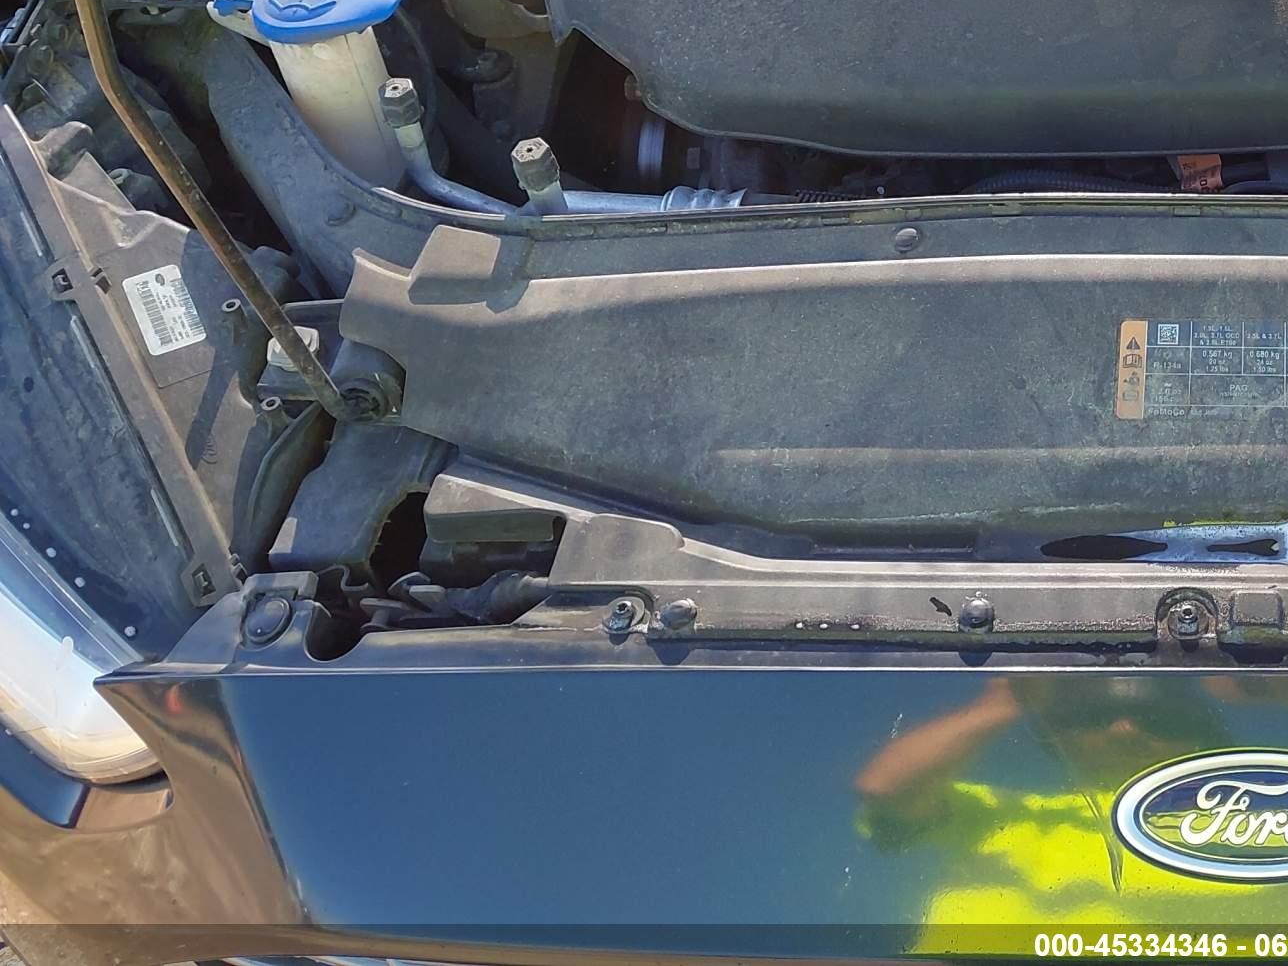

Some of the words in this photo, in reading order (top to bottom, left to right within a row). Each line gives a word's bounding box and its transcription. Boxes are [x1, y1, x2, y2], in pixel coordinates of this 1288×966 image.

[1223, 350, 1233, 359] kg
[1270, 351, 1280, 360] kg
[1229, 384, 1248, 392] PAG
